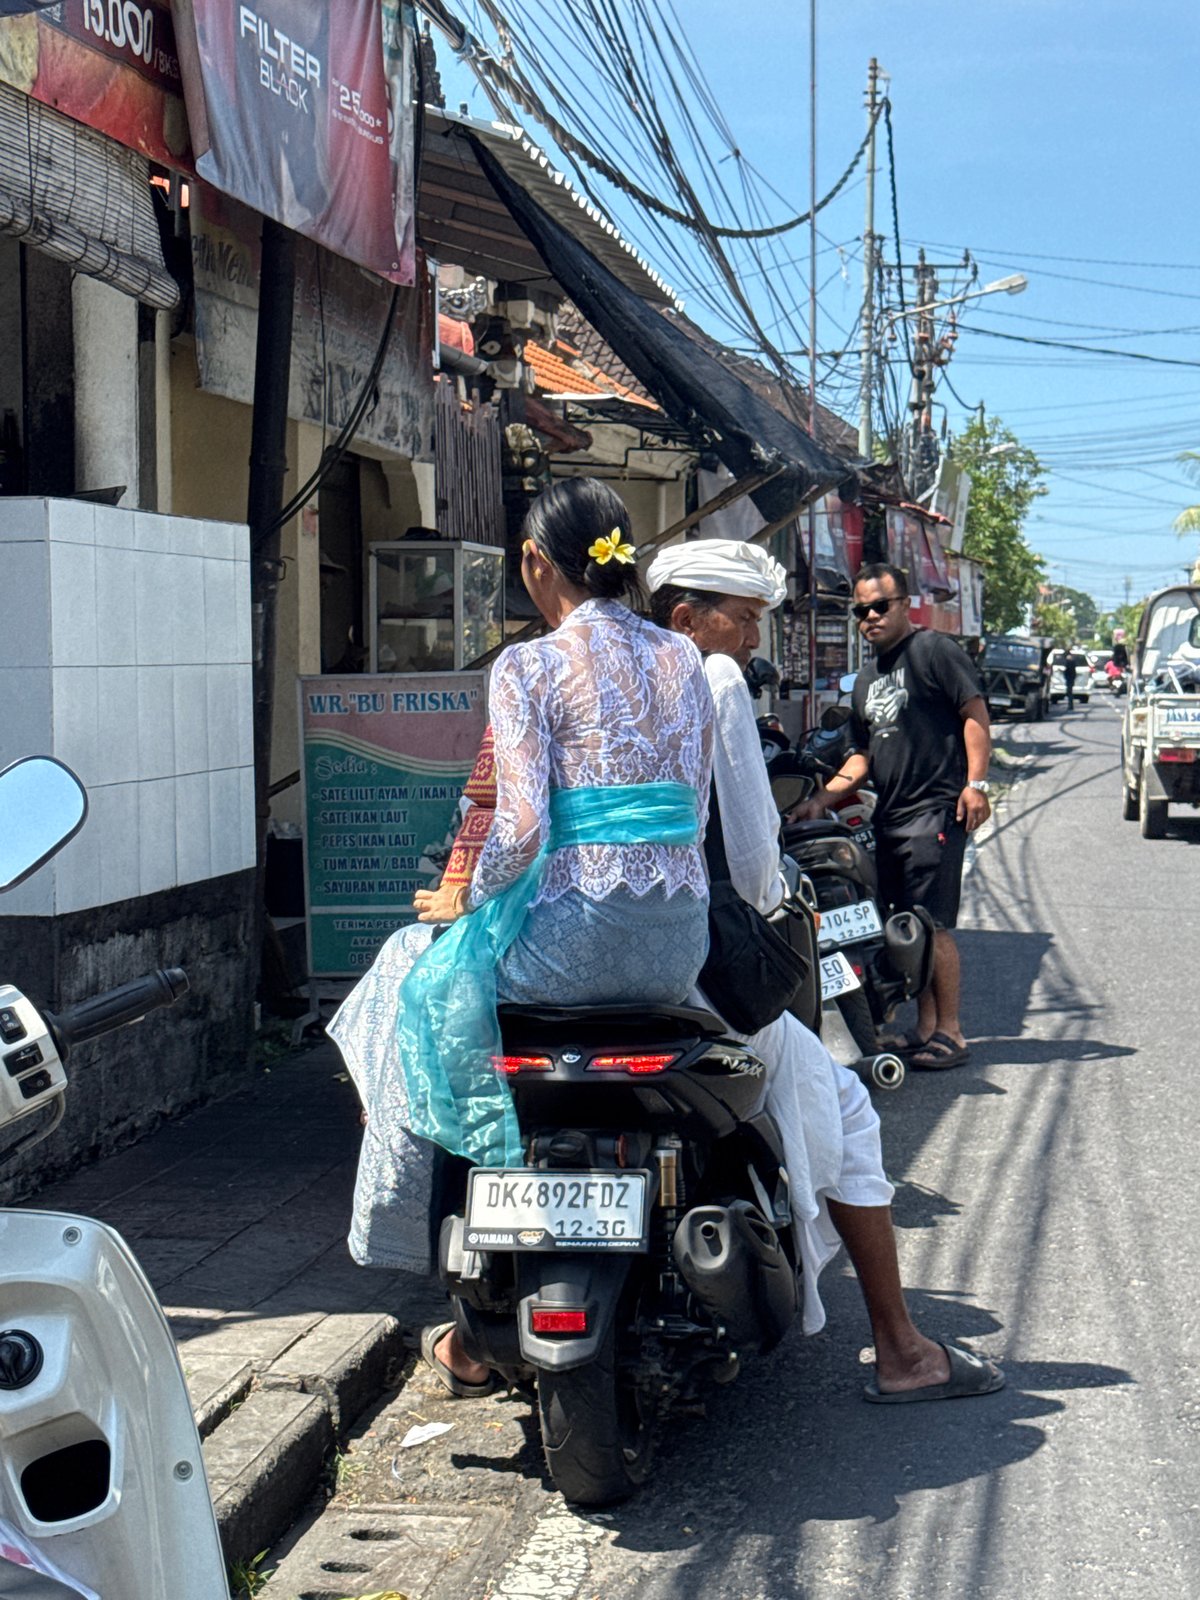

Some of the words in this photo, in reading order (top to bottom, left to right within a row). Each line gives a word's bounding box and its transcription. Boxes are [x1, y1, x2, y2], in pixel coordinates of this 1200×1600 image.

[240, 5, 320, 88] FILTER
[260, 57, 308, 114] BLACK
[392, 690, 478, 712] FRISKA"
[320, 788, 347, 801] SATE
[350, 788, 375, 800] LILIT
[378, 787, 408, 800] AYAM
[419, 787, 447, 799] IKAN
[320, 812, 348, 825] SATE
[350, 811, 378, 824] IKAN
[380, 811, 408, 823] LAUT
[322, 835, 355, 848] PEPES
[358, 834, 386, 847] IKAN
[388, 833, 417, 846] LAUT
[323, 858, 347, 870] TUM
[349, 857, 380, 870] AYAM
[391, 857, 419, 869] BABI
[323, 881, 375, 894] SAYURAN
[378, 880, 424, 893] MATANG
[820, 911, 851, 929] 104
[854, 905, 870, 920] SP
[335, 920, 373, 930] TERIMA
[352, 937, 381, 946] AYAM
[478, 1233, 514, 1245] YAMAHA
